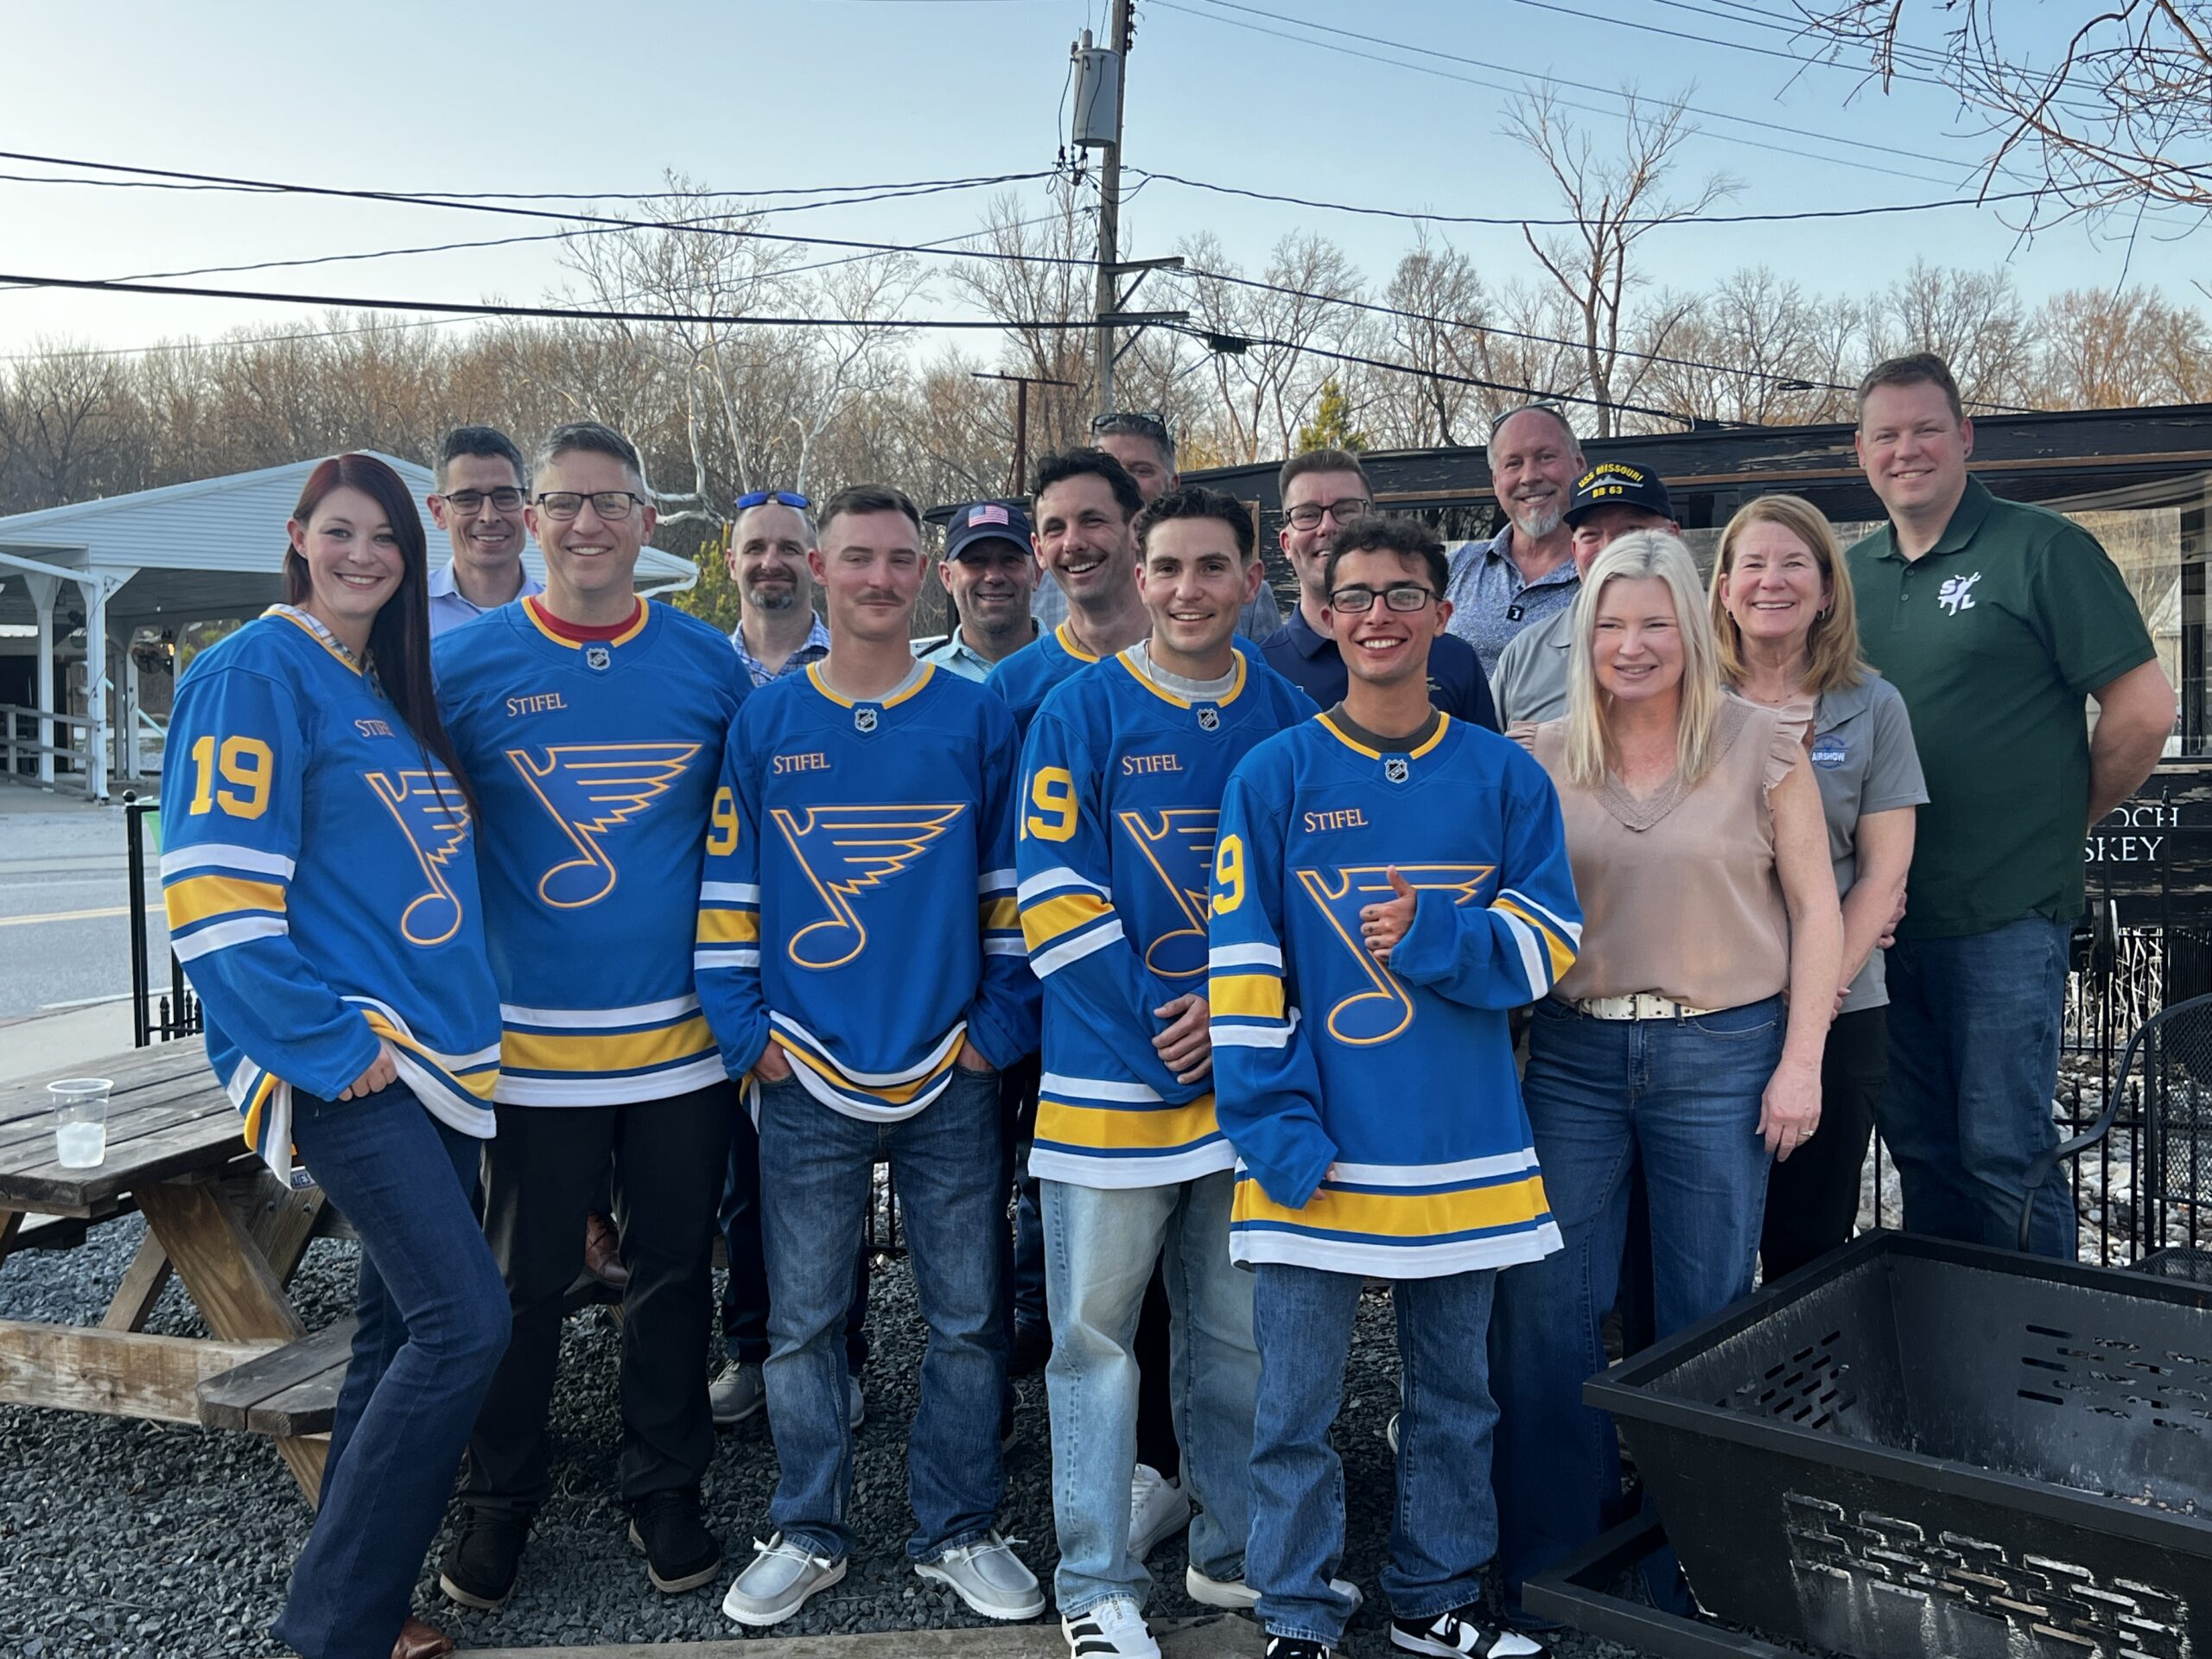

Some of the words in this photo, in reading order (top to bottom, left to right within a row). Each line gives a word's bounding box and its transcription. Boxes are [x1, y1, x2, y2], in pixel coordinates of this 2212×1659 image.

[1578, 472, 1595, 488] USS
[1596, 463, 1644, 482] MISSOURI
[1609, 486, 1623, 494] 63
[506, 693, 568, 717] STIFEL
[773, 752, 831, 775] STIFEL
[1122, 753, 1184, 776] STIFEL
[1811, 752, 1846, 762] AIRSHOW
[189, 734, 274, 821] 19
[1020, 766, 1079, 842] 9
[1303, 808, 1369, 833] STIFEL
[1208, 833, 1245, 919] 9
